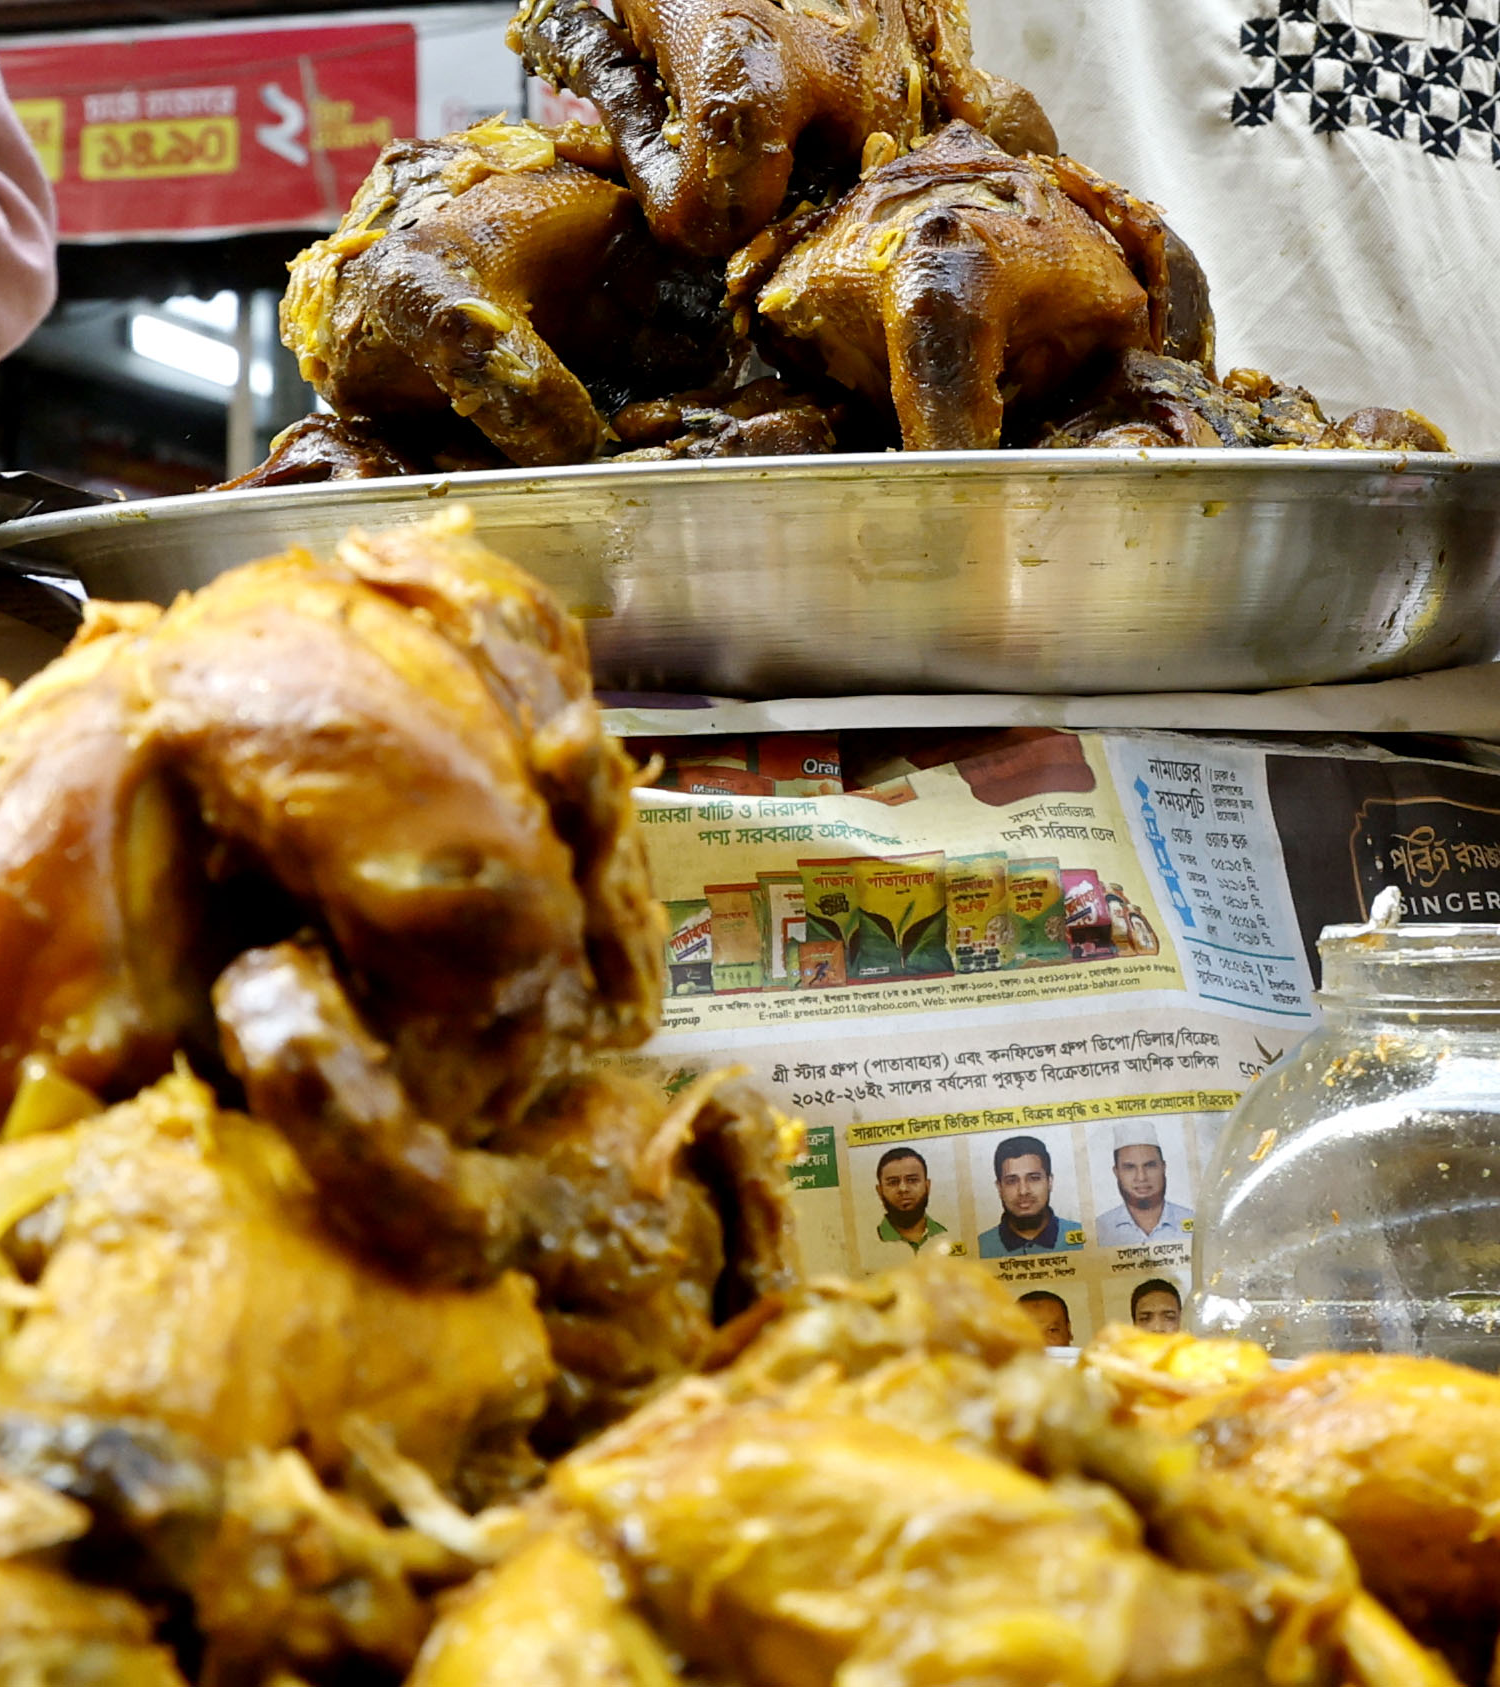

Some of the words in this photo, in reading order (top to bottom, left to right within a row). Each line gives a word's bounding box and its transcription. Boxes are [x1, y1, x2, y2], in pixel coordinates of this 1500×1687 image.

[1148, 757, 1202, 784] নামাজের
[637, 806, 692, 825] আমরা
[697, 799, 734, 822] খাঁটি
[739, 802, 753, 819] ও
[757, 798, 819, 818] নিরাপদ
[1009, 803, 1046, 823] সম্পূর্ণ
[1154, 787, 1206, 820] সময়সূচি
[698, 829, 731, 846] পণ্য
[736, 824, 814, 845] সরবরাহে
[1000, 823, 1038, 843] দেশী
[1039, 821, 1090, 842] সরিষার
[1091, 825, 1118, 844] তেল
[1390, 824, 1451, 889] পবিত্র
[759, 1010, 792, 1021] E-mail:
[922, 995, 948, 1008] Web:
[1041, 976, 1141, 995] www.pata-bahar.com
[794, 1063, 826, 1081] স্টার
[830, 1061, 859, 1078] গ্রুপ
[864, 1052, 949, 1079] (পাতাবাহার)
[955, 1052, 983, 1068] এবং
[1060, 1041, 1088, 1057] গ্রুপ
[792, 1081, 886, 1109] ২০২৫-২৬ইং
[888, 1079, 932, 1097] সালের
[937, 1072, 987, 1091] বর্ষসেরা
[1041, 1060, 1120, 1083] বিক্রেতাদের
[1124, 1053, 1174, 1073] আংশিক
[1178, 1051, 1220, 1070] তালিকা
[852, 1125, 905, 1142] সারাদেশে
[908, 1118, 941, 1135] ডিলার
[1117, 1244, 1150, 1261] গোলাপ
[1153, 1242, 1185, 1255] হোসেন
